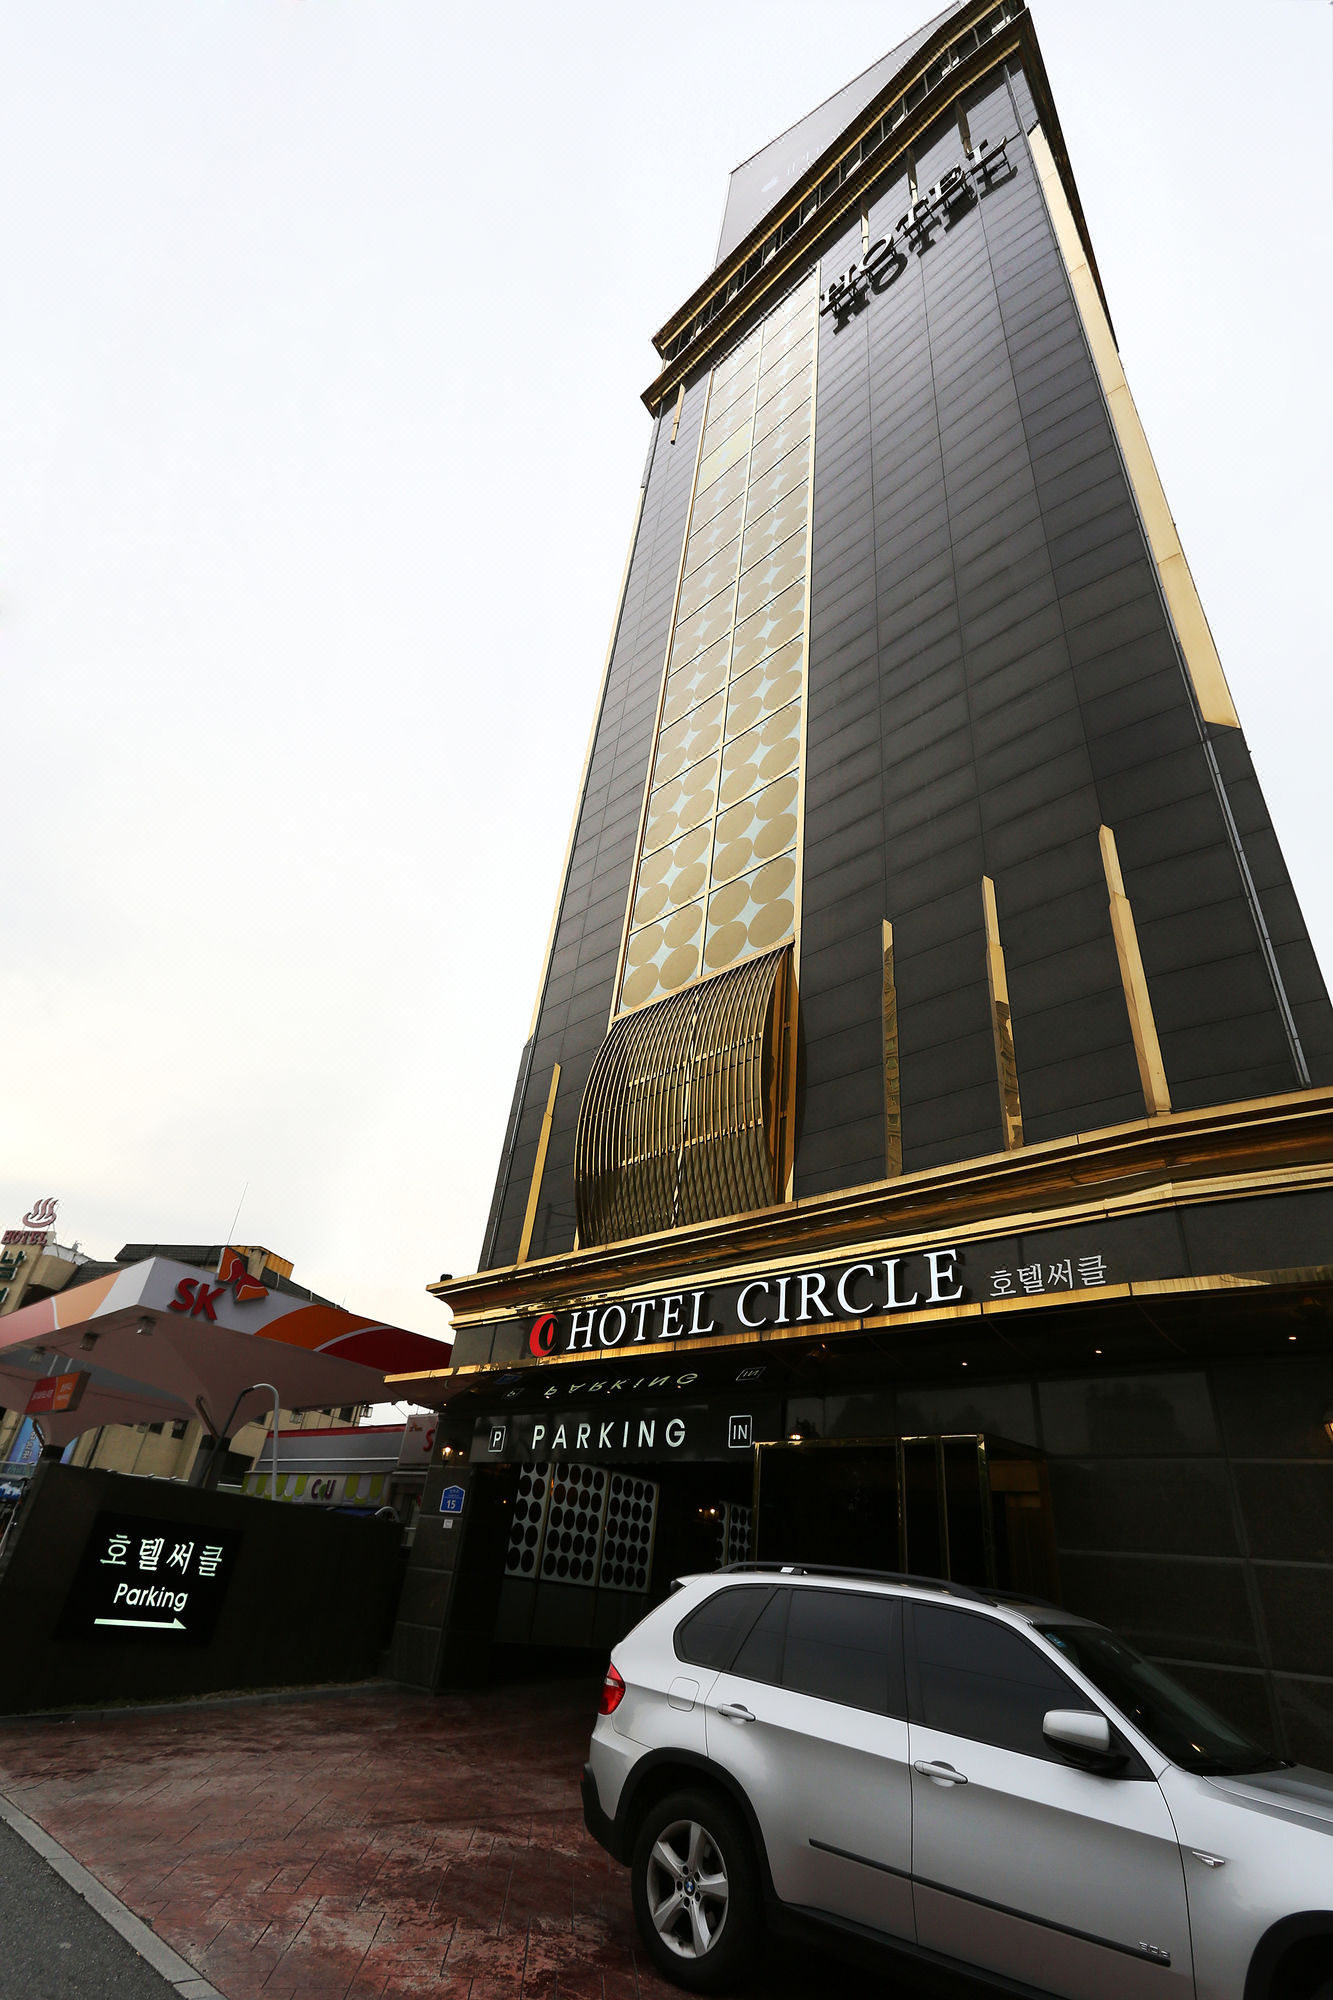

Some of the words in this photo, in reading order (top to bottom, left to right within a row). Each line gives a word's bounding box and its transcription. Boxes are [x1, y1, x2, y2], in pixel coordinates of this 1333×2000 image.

[820, 135, 1009, 316] HOTEL
[1, 1230, 48, 1245] HOTEL
[989, 1254, 1108, 1298] 호텔써클
[168, 1277, 226, 1321] SK
[565, 1291, 715, 1351] HOTEL
[736, 1248, 964, 1329] CIRCLE
[491, 1430, 503, 1448] P
[531, 1418, 687, 1450] PARKING
[732, 1423, 749, 1440] IN
[310, 1478, 338, 1500] CU
[446, 1499, 457, 1510] 15
[99, 1532, 225, 1578] 호텔써클
[112, 1582, 189, 1612] Parking
